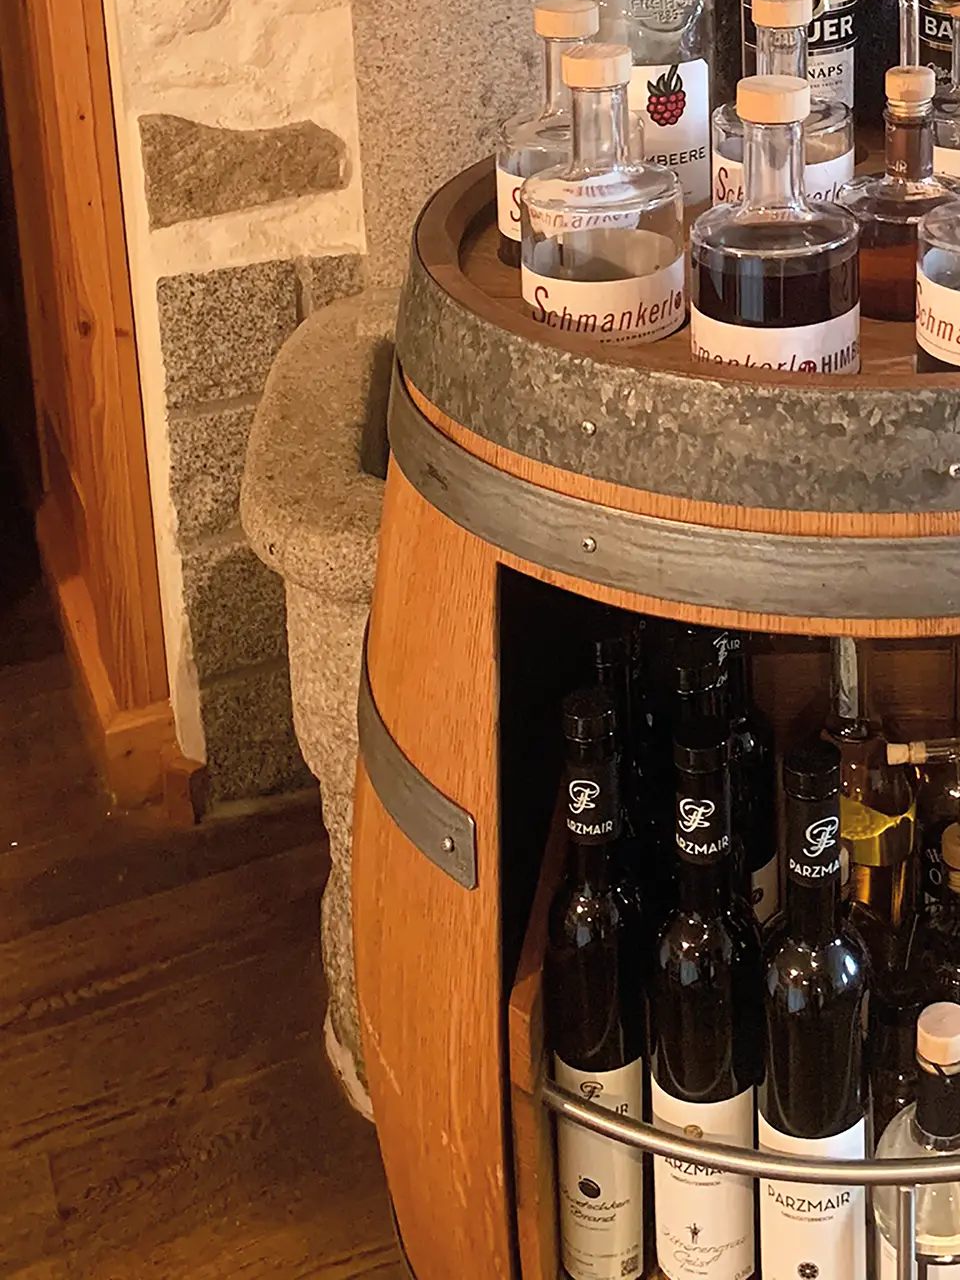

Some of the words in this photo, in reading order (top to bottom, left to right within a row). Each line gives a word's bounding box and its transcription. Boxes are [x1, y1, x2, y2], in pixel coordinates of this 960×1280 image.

[808, 13, 854, 43] UER
[808, 64, 843, 79] NAPS
[646, 146, 706, 167] BEERE
[532, 285, 674, 333] Schmankerl
[566, 818, 613, 835] RZMAIR
[676, 833, 730, 855] RZMAIR
[789, 858, 840, 878] PARZMA
[767, 1183, 851, 1213] PARZMAIR
